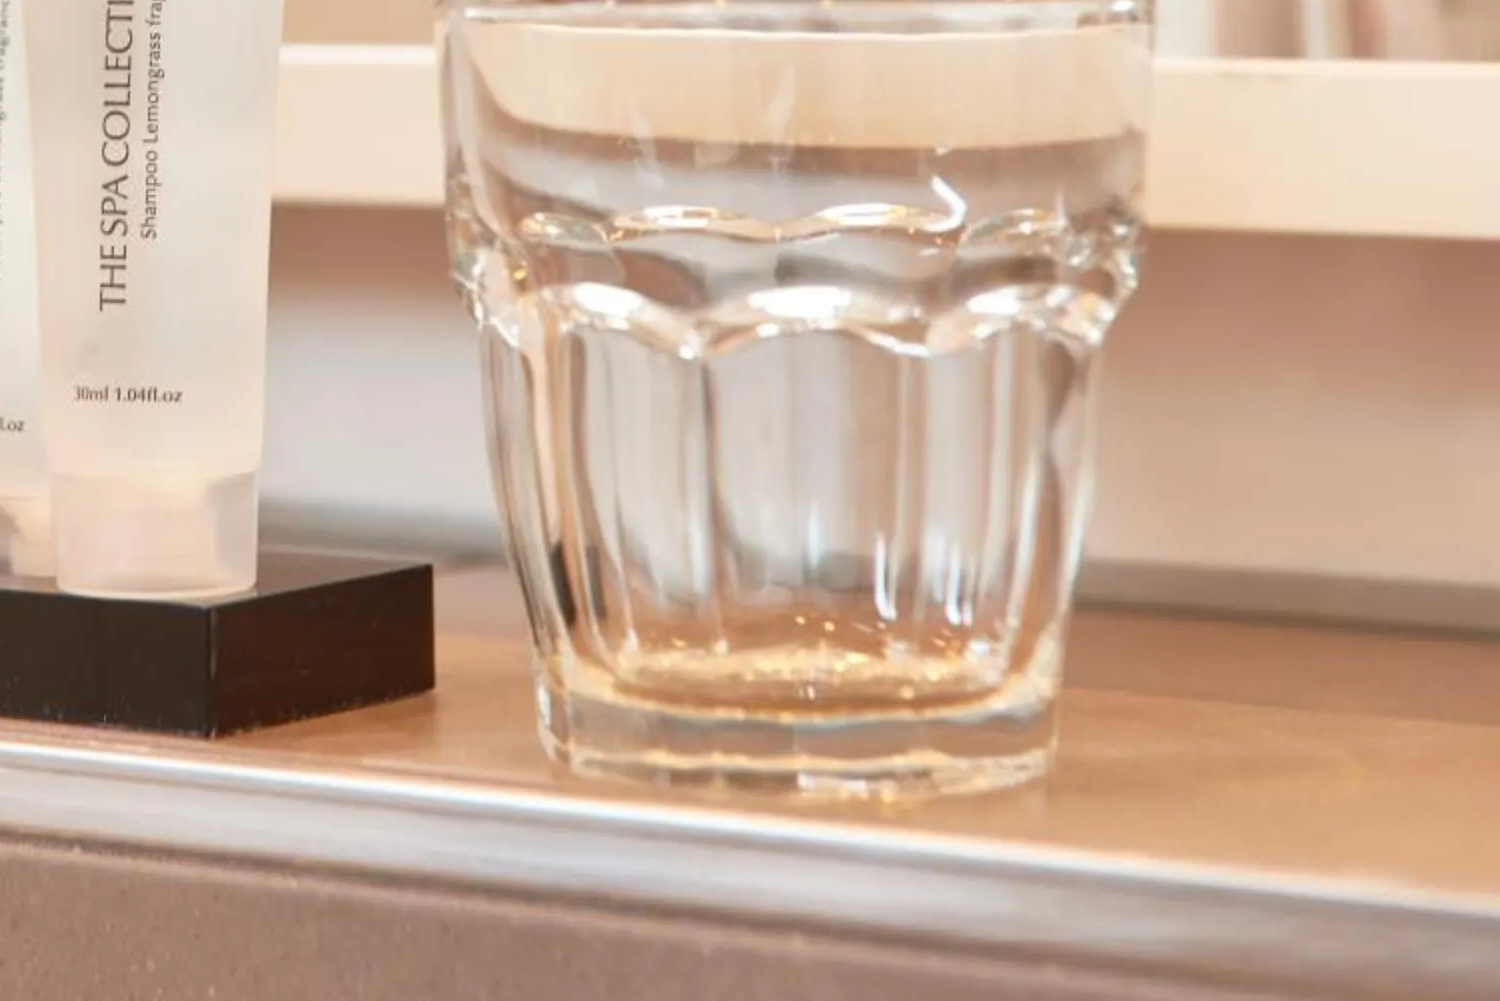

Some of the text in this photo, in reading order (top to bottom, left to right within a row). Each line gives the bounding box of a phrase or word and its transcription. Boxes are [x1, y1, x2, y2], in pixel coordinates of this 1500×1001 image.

[143, 32, 166, 143] Lemongrass
[100, 174, 129, 237] SPA
[140, 150, 163, 240] Shampoo
[99, 245, 128, 312] THE
[116, 385, 183, 402] 1.04fl.oz
